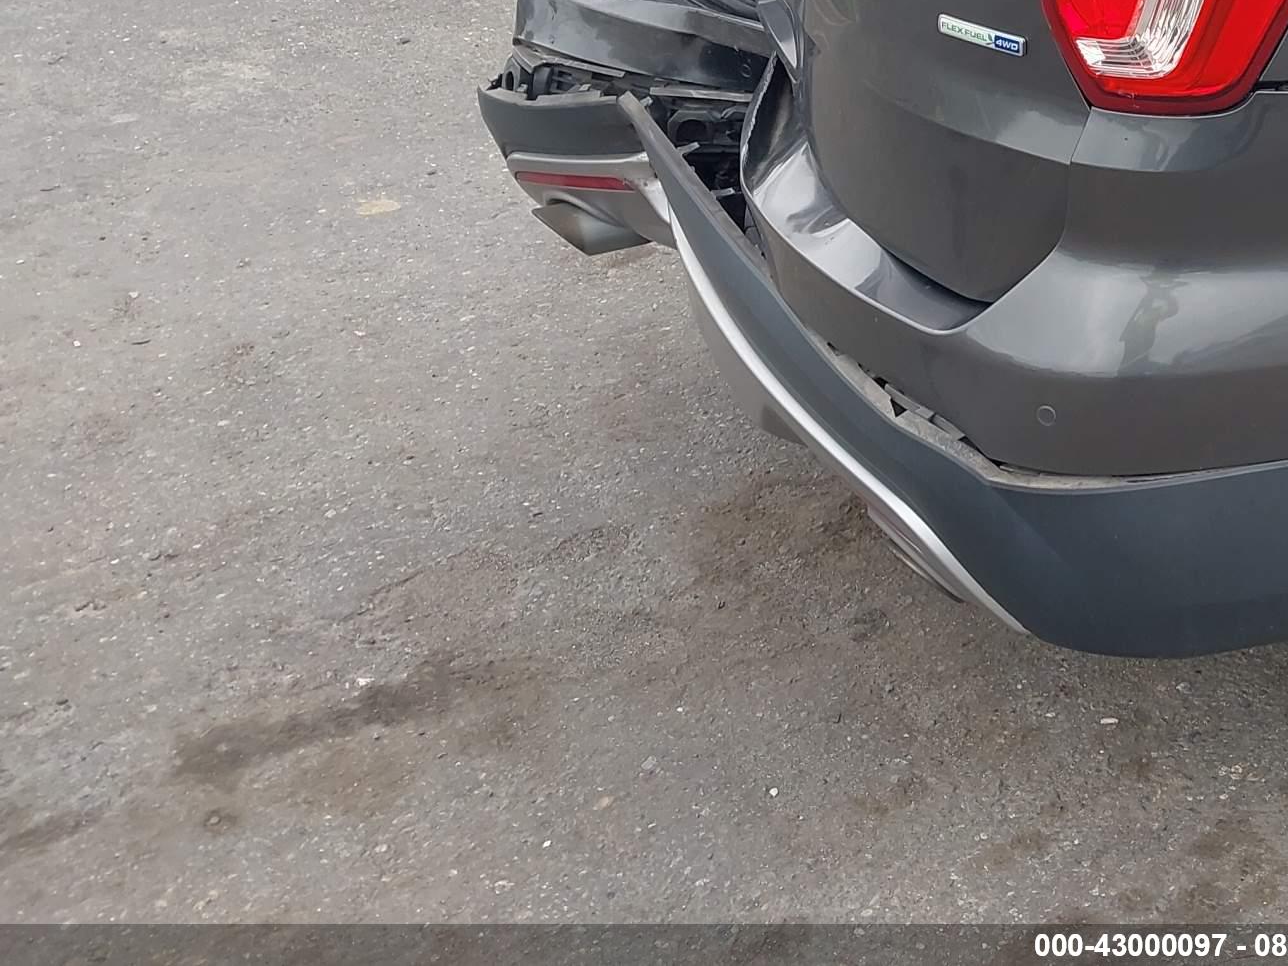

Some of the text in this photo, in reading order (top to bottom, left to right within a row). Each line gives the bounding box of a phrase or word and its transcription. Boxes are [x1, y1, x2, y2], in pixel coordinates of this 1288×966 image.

[941, 20, 988, 42] FLEX FUEL
[995, 38, 1019, 52] 4WD
